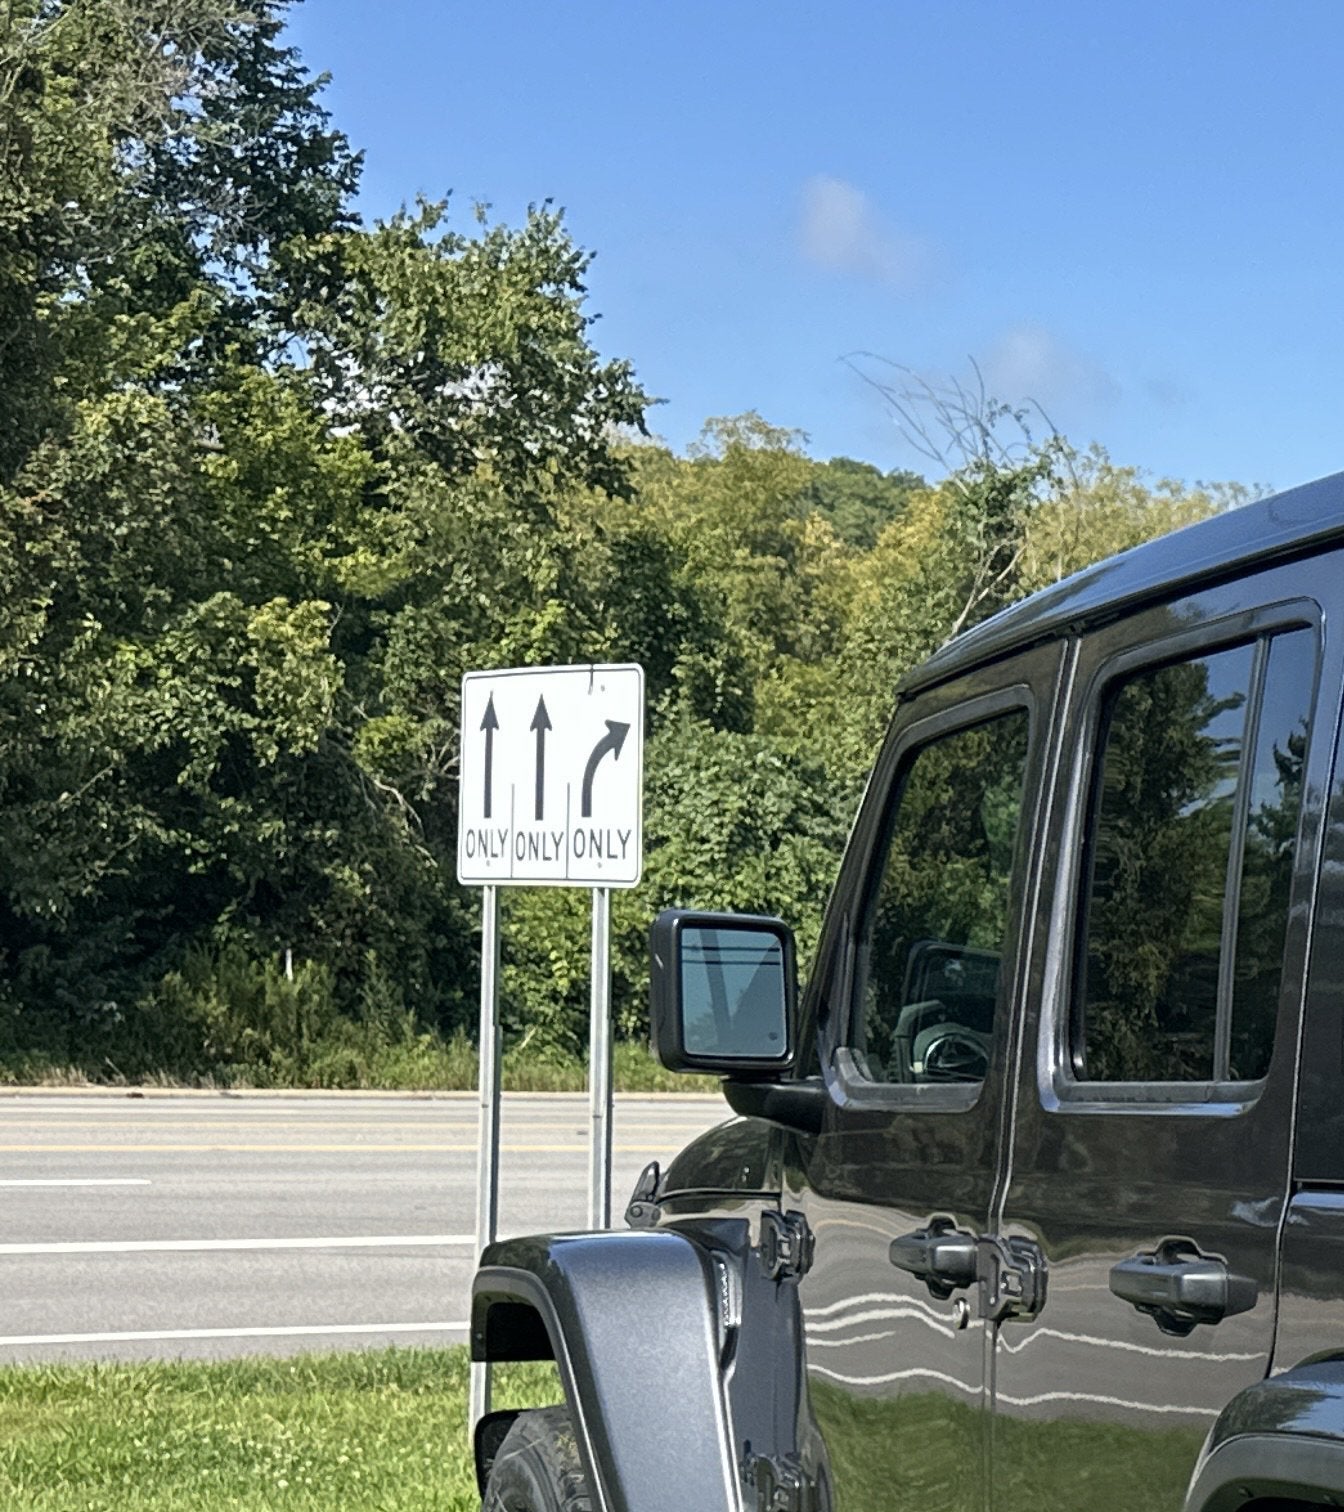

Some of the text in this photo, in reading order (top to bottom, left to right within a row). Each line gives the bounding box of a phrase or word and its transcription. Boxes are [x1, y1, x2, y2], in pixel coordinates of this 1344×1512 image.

[466, 829, 508, 859] ONLY
[515, 831, 564, 861] ONLY
[573, 828, 631, 859] ONLY
